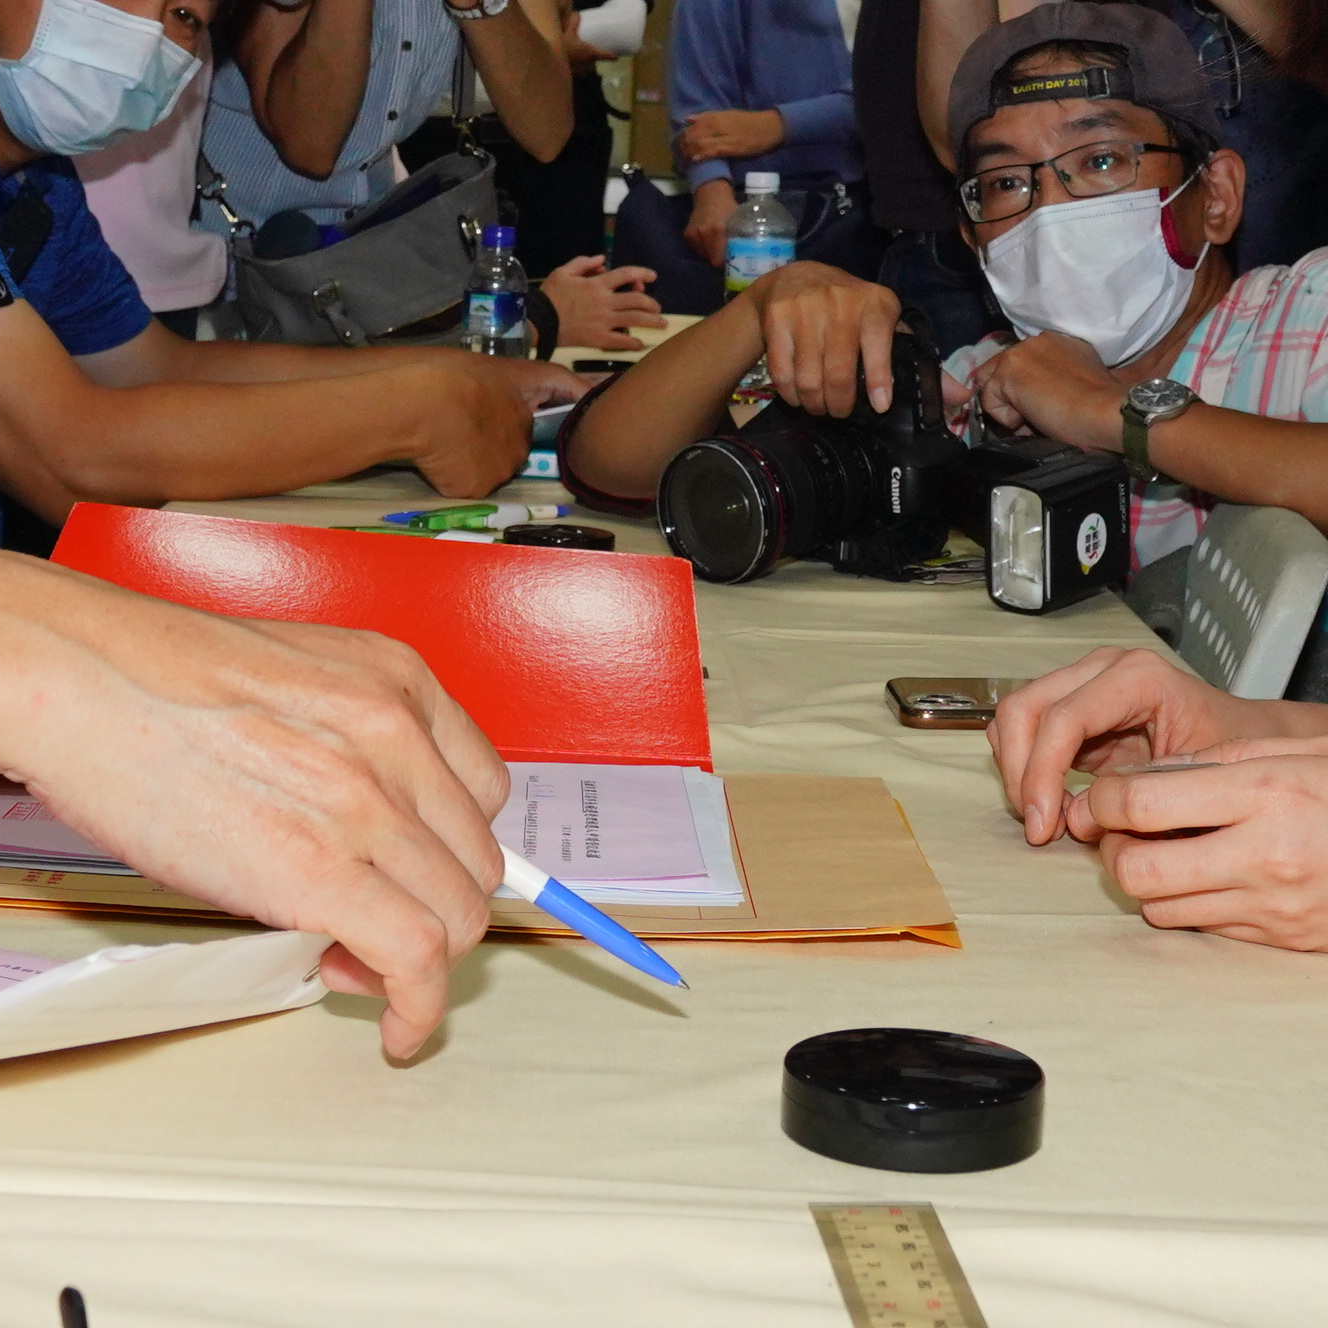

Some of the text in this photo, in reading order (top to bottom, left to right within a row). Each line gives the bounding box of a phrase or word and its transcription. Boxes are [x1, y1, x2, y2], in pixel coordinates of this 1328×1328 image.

[1013, 83, 1044, 94] EARTH
[1045, 79, 1066, 89] DAY
[891, 466, 902, 514] Canon
